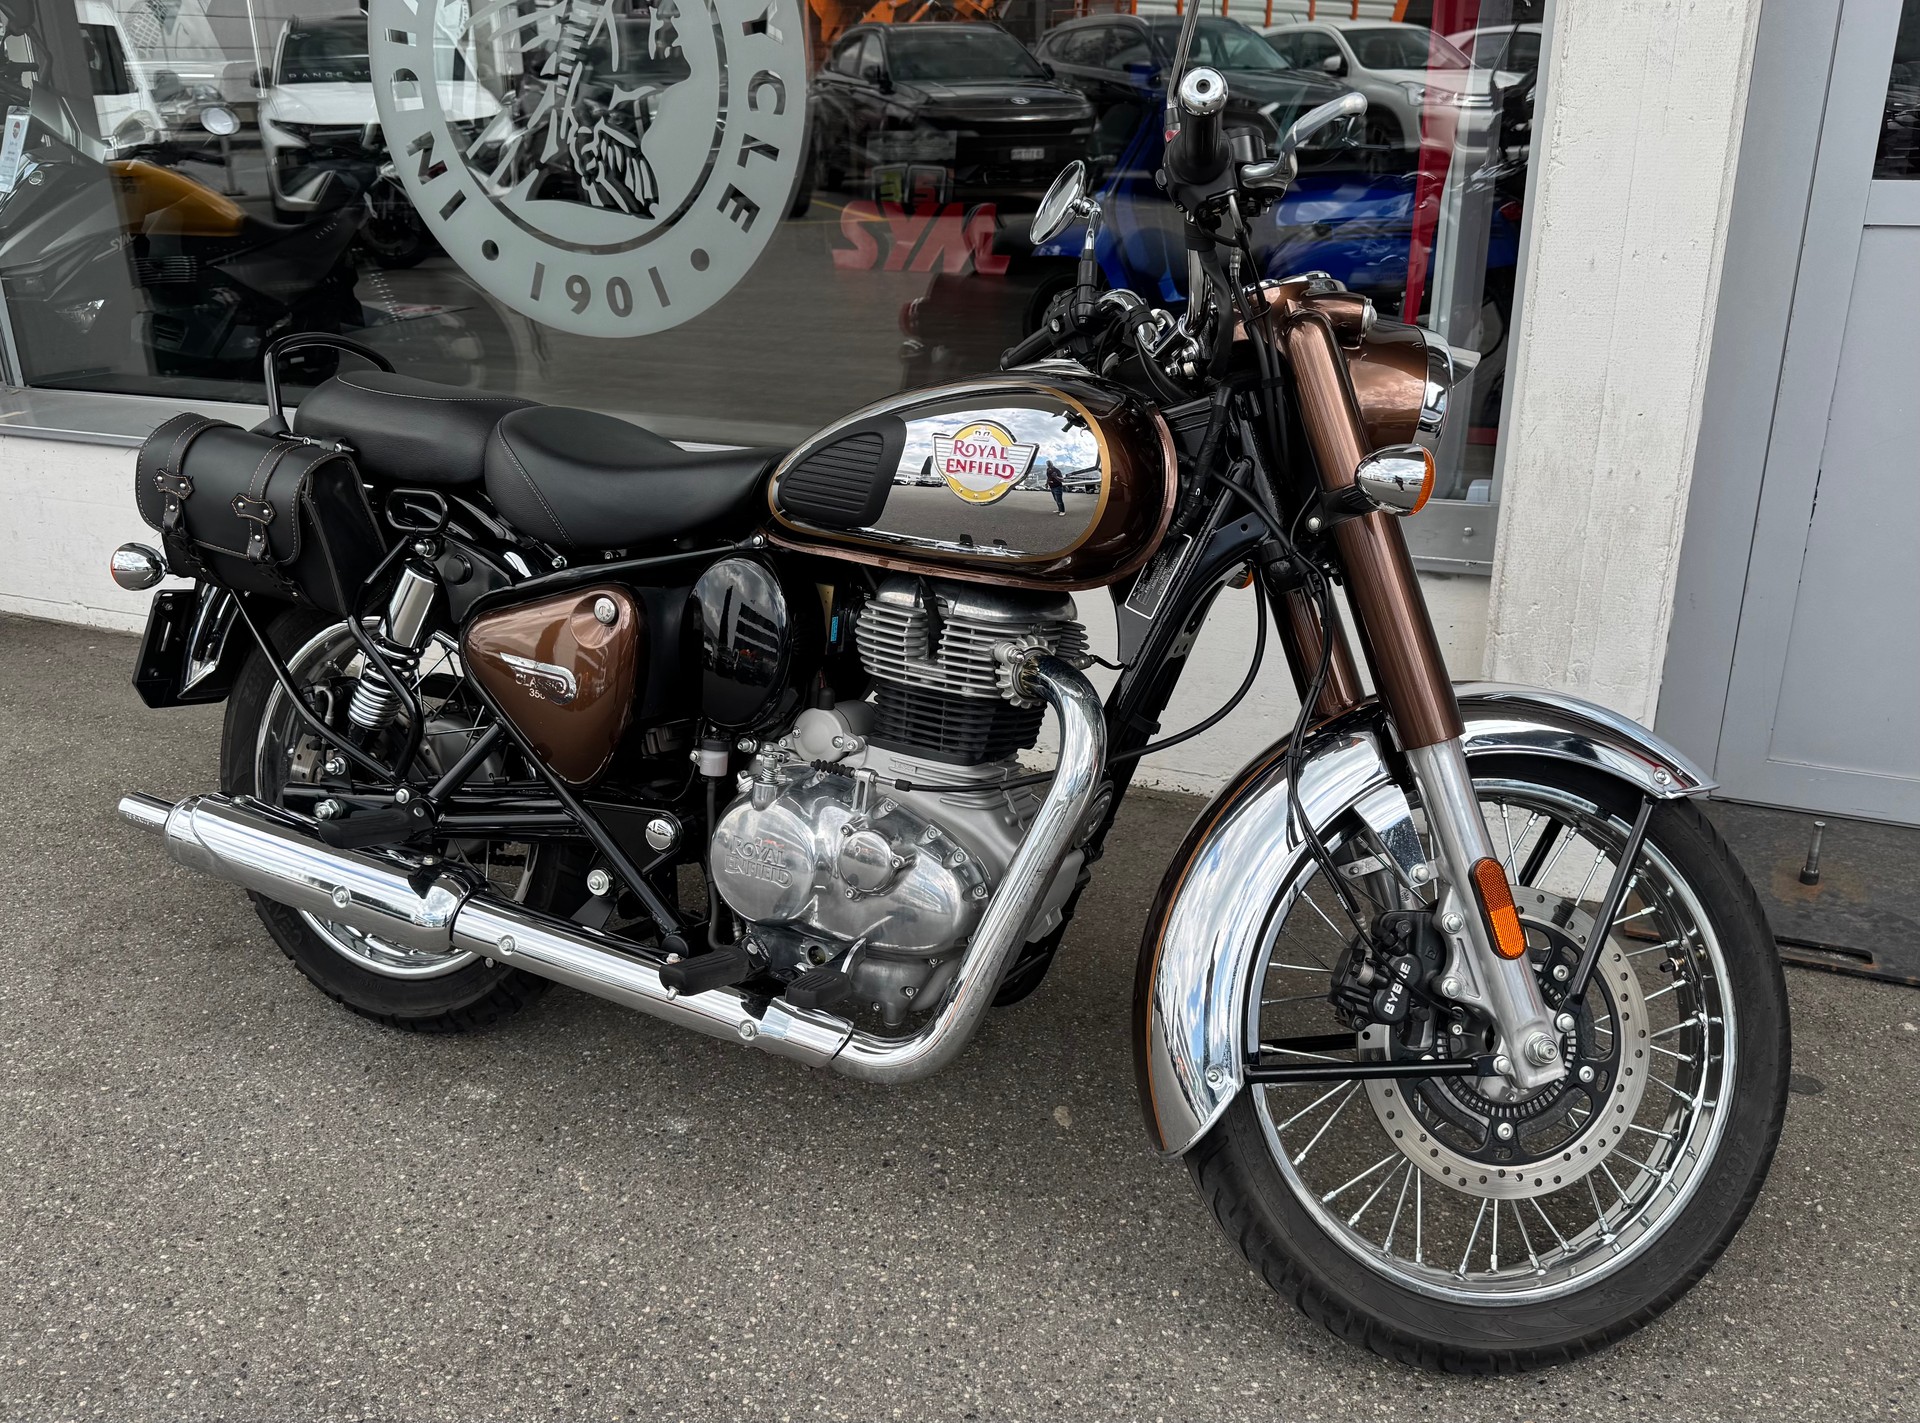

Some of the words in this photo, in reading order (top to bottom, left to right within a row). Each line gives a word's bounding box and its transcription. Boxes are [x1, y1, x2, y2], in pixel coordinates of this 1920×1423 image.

[384, 0, 467, 221] INDI
[530, 262, 671, 317] 1901
[952, 439, 1010, 460] ROYAL
[945, 458, 1015, 480] ENFIELD
[730, 835, 788, 868] ROYAL
[724, 854, 794, 888] ENFIELD
